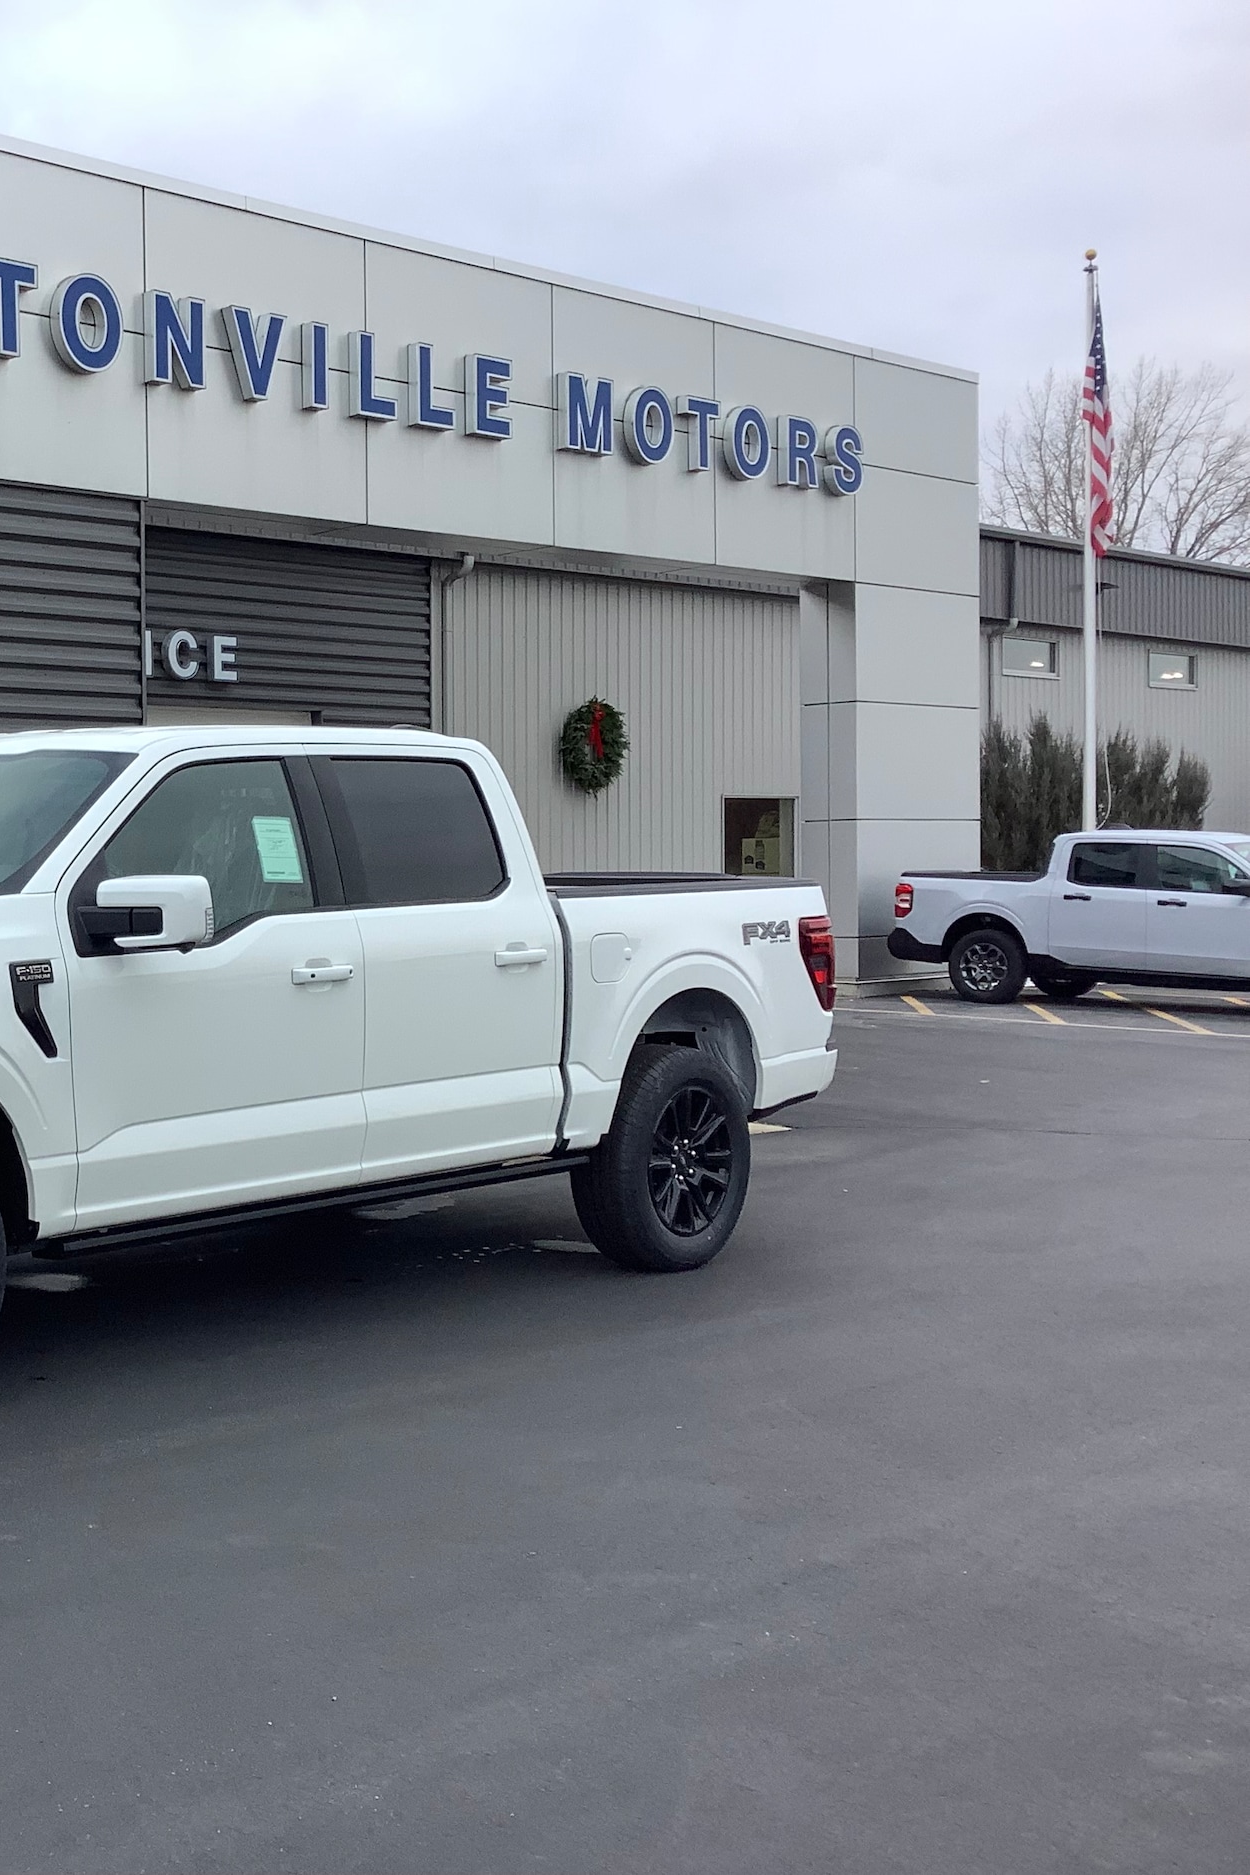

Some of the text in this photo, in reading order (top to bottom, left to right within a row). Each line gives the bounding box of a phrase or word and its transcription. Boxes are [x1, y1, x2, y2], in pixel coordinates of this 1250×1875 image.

[556, 370, 864, 497] MOTORS
[742, 920, 790, 946] FX4
[15, 964, 52, 976] F-150
